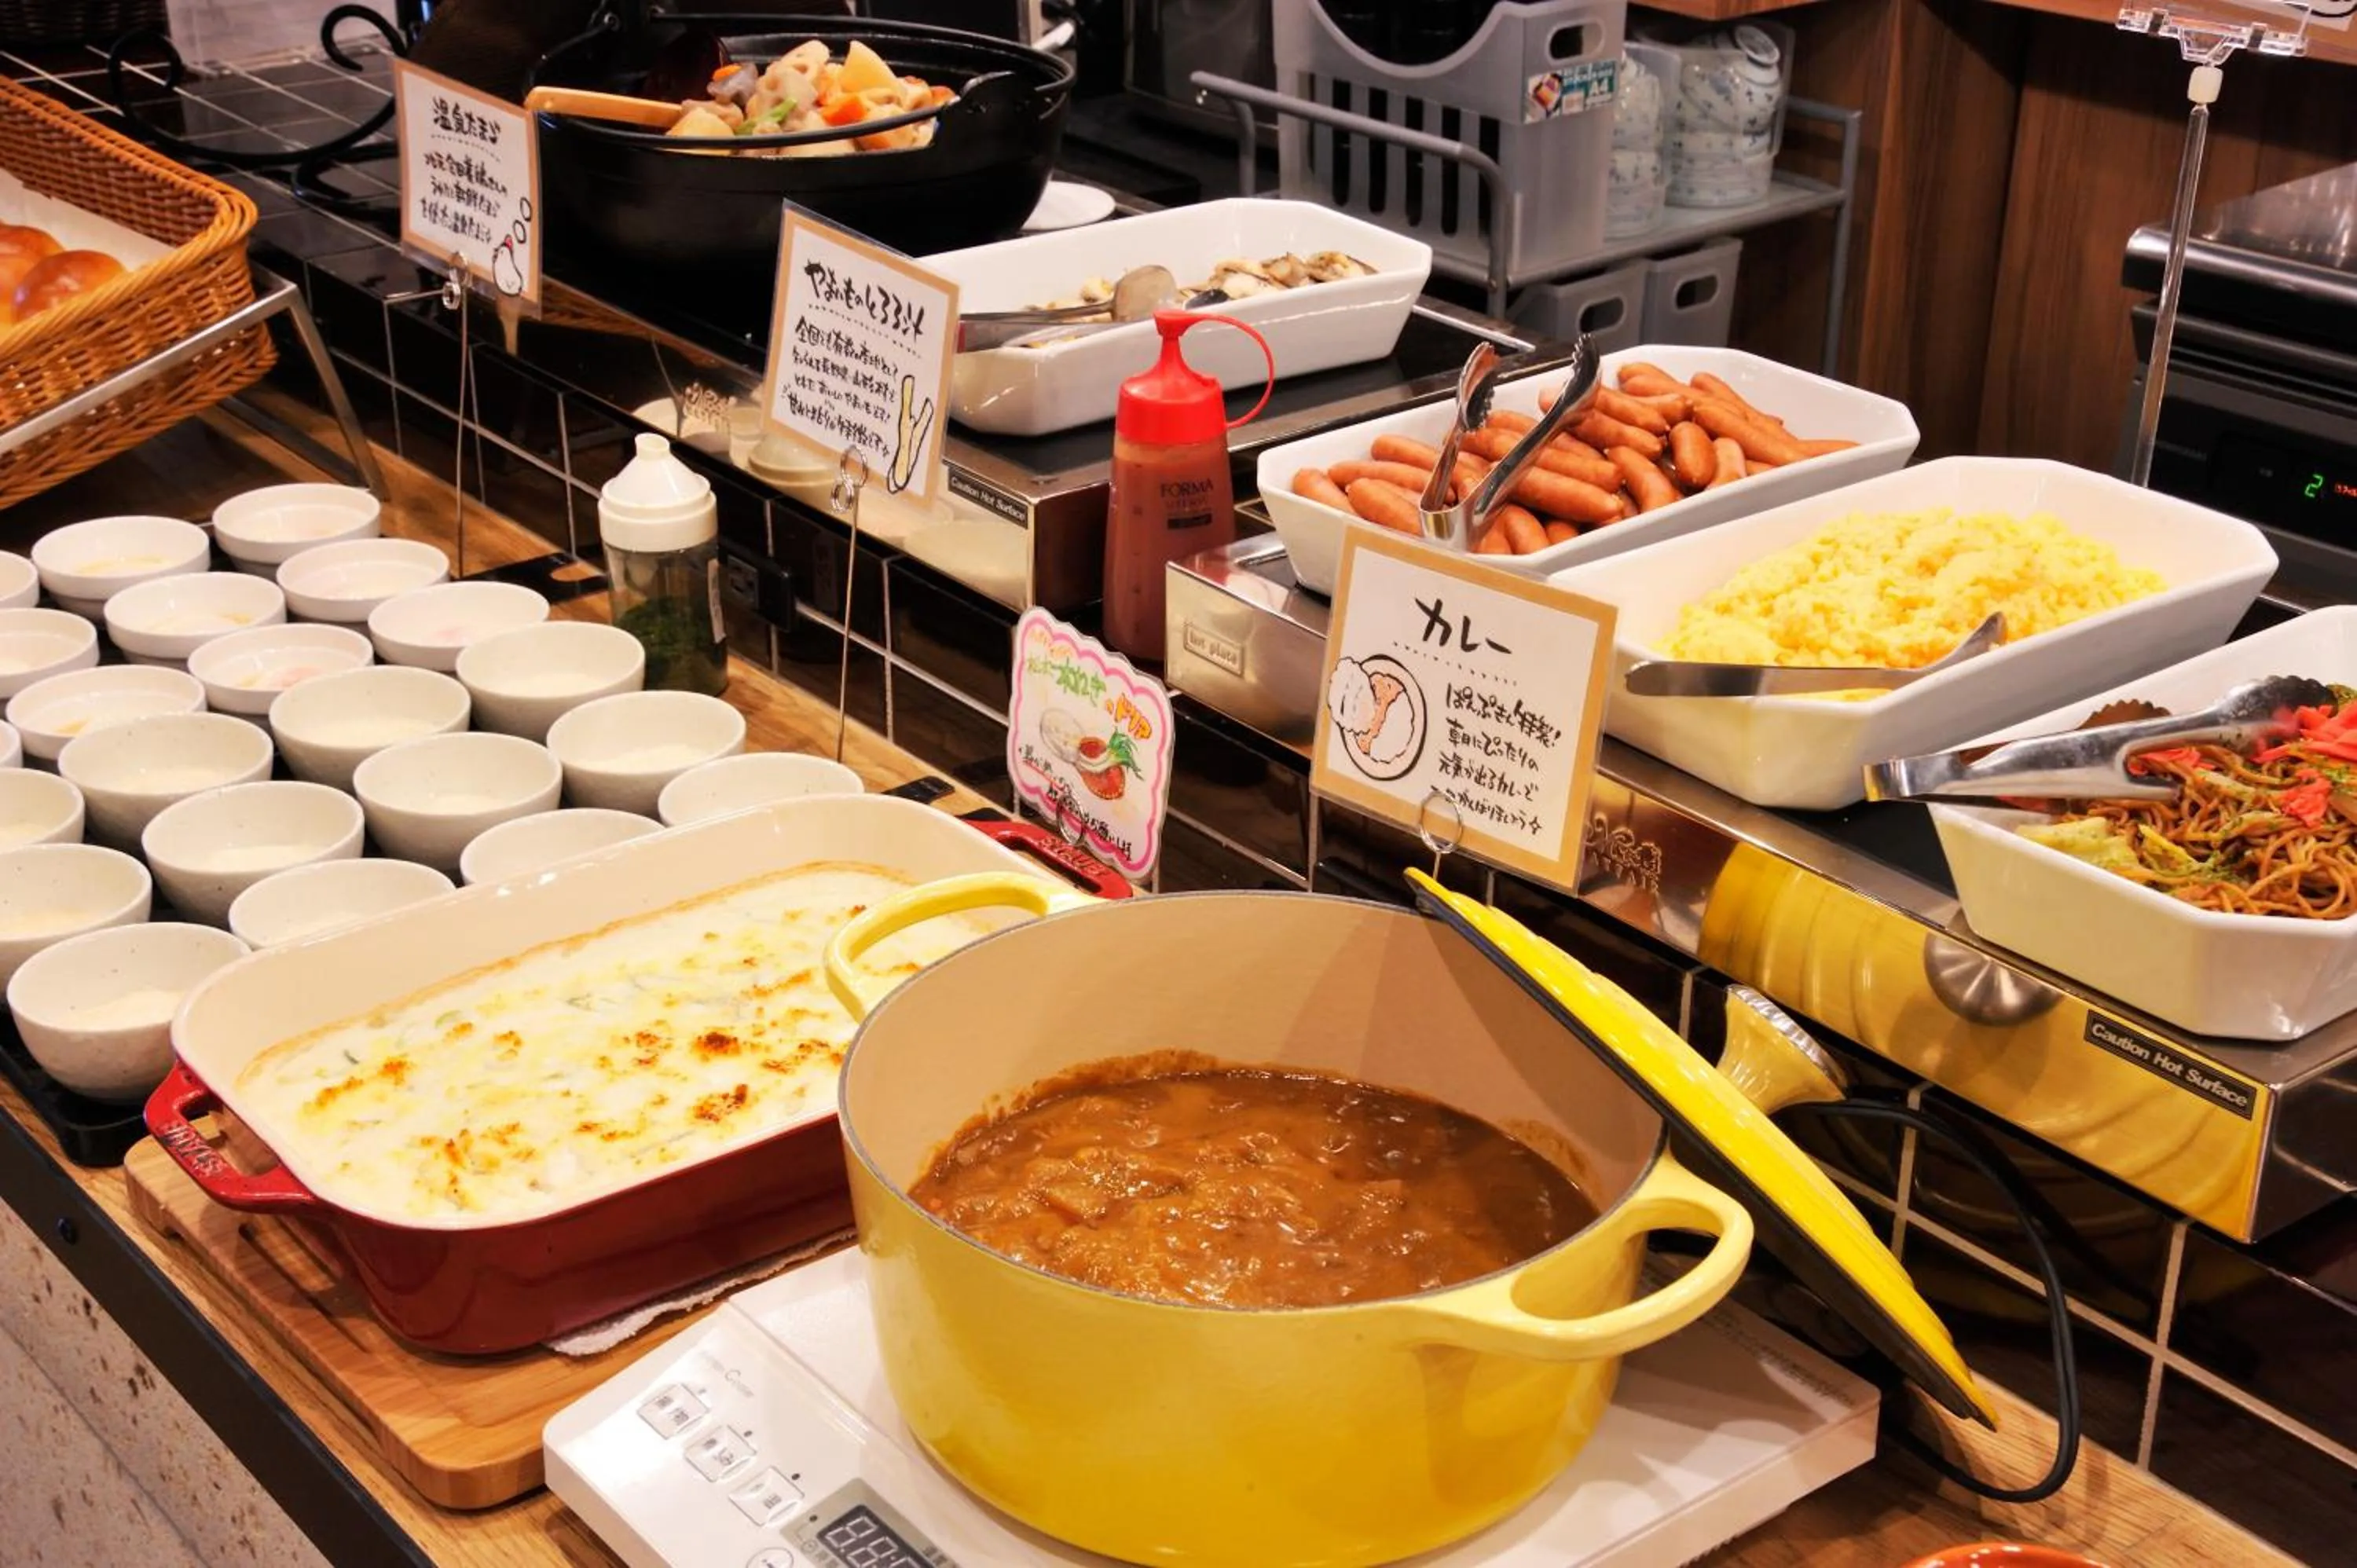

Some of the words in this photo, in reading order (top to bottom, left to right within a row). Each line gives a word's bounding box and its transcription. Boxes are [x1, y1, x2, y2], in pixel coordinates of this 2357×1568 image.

[951, 476, 980, 499] Caution
[980, 491, 995, 506] Hot
[995, 499, 1025, 522] Surface
[1160, 478, 1214, 498] FORMA
[2304, 473, 2324, 499] 2
[1414, 598, 1512, 655] カレー
[2091, 1023, 2150, 1060] Caution
[2153, 1051, 2184, 1077] Hot
[2185, 1068, 2248, 1108] Surface
